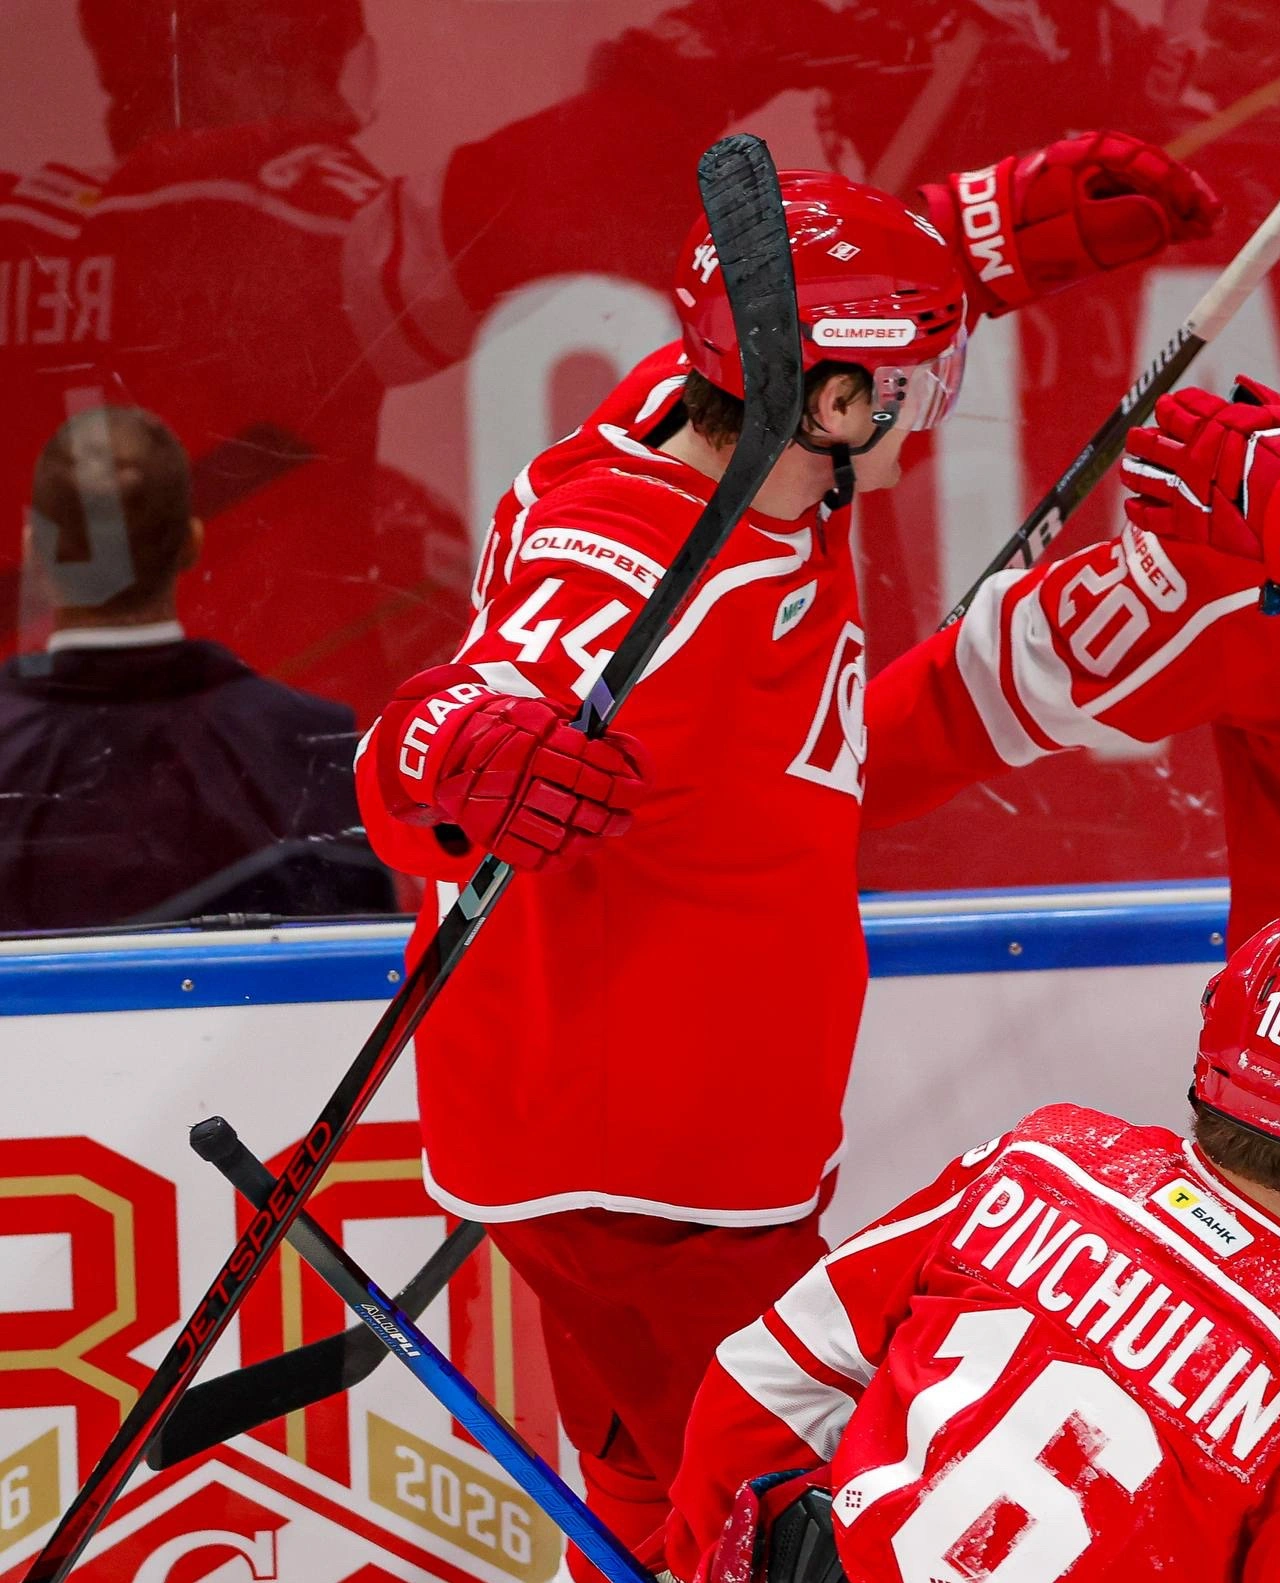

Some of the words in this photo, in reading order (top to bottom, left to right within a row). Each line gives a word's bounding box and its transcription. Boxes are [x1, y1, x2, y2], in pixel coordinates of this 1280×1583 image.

[822, 327, 908, 339] OLIMPBET
[530, 536, 663, 590] OLIMPBET
[1057, 543, 1151, 679] 20
[1131, 526, 1178, 597] MPBET
[497, 577, 632, 701] 44
[177, 1121, 332, 1374] JETSPEED
[1191, 1206, 1237, 1245] БАНК
[394, 1444, 532, 1565] 2026
[832, 1305, 1163, 1583] 16
